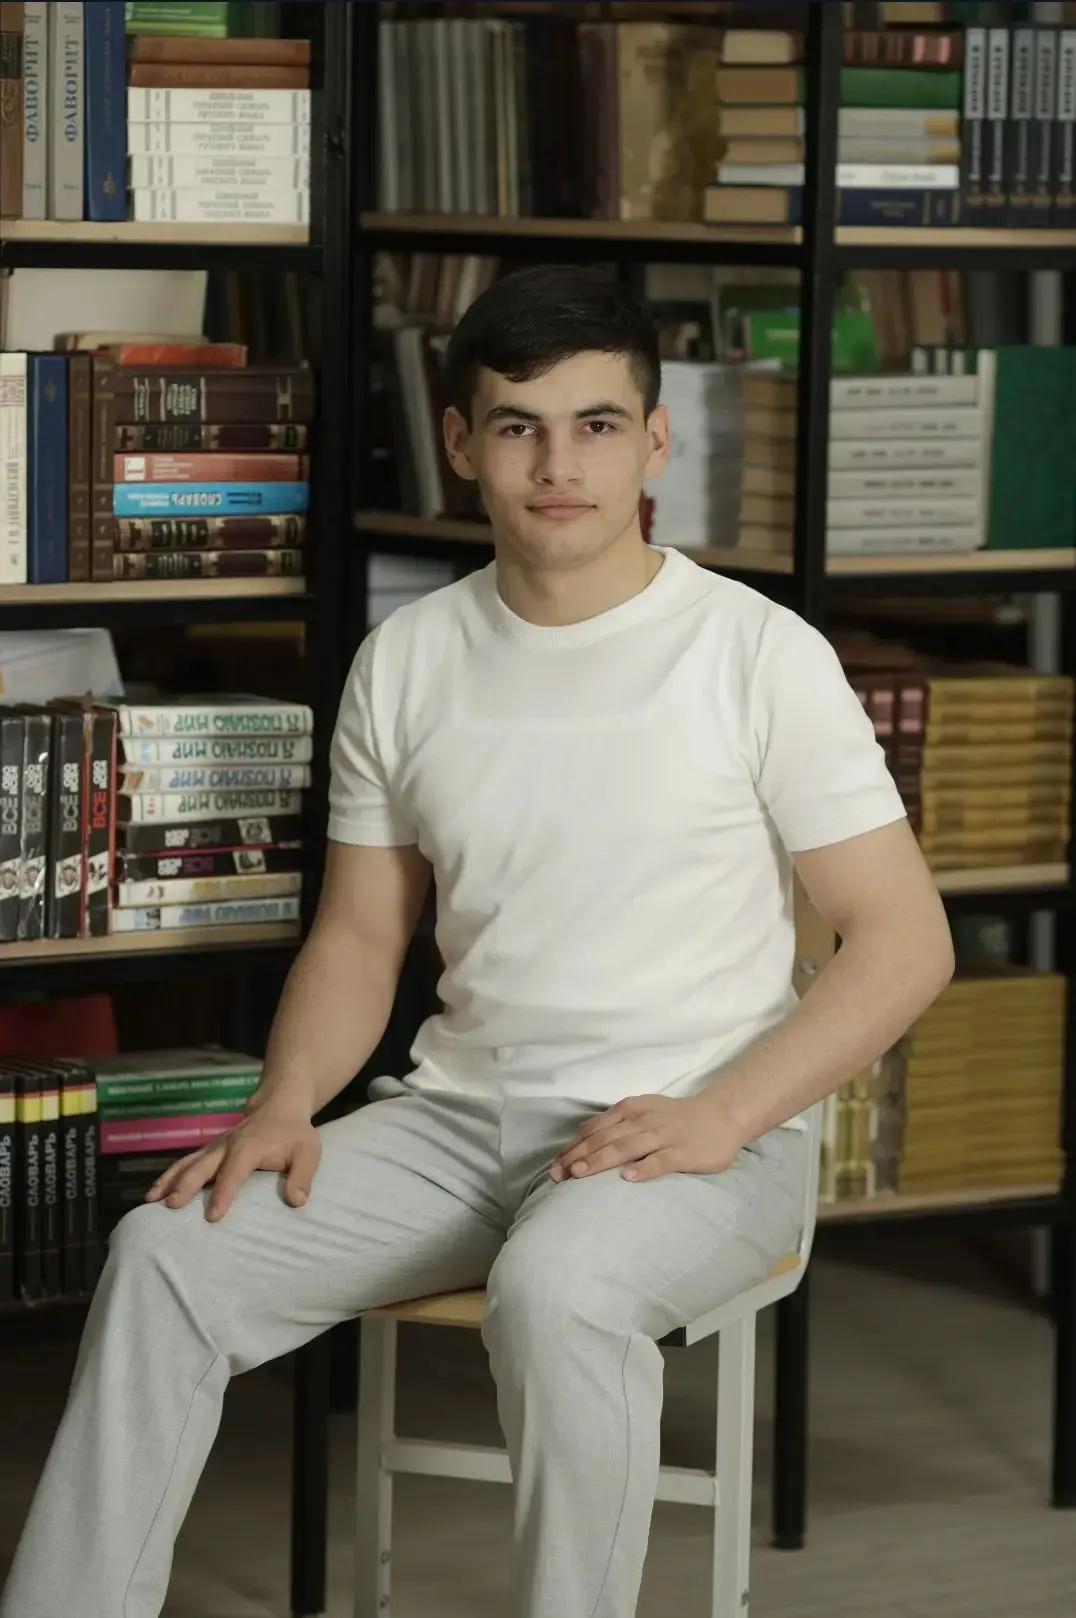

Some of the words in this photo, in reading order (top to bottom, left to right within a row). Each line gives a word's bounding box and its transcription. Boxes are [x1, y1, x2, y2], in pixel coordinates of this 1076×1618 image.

[24, 34, 40, 143] ФАВОРИТ
[64, 35, 79, 143] ФАВОРИТ
[170, 492, 222, 506] СЛОВАРЬ
[174, 714, 208, 732] МИР
[212, 714, 283, 732] ПОЗНАЮ
[286, 714, 300, 732] Я
[172, 742, 206, 760] МИР
[210, 741, 278, 759] ПОЗНАЮ
[282, 740, 295, 759] Я
[169, 771, 204, 788] МИР
[209, 769, 276, 788] ПОЗНАЮ
[280, 768, 292, 788] Я
[178, 794, 209, 813] МИР
[215, 791, 276, 810] ПОЗНАЮ
[27, 1133, 39, 1207] СЛОВАРЬ
[45, 1132, 57, 1205] СЛОВАРЬ
[65, 1127, 77, 1200] СЛОВАРЬ
[84, 1125, 96, 1198] СЛОВАРЬ
